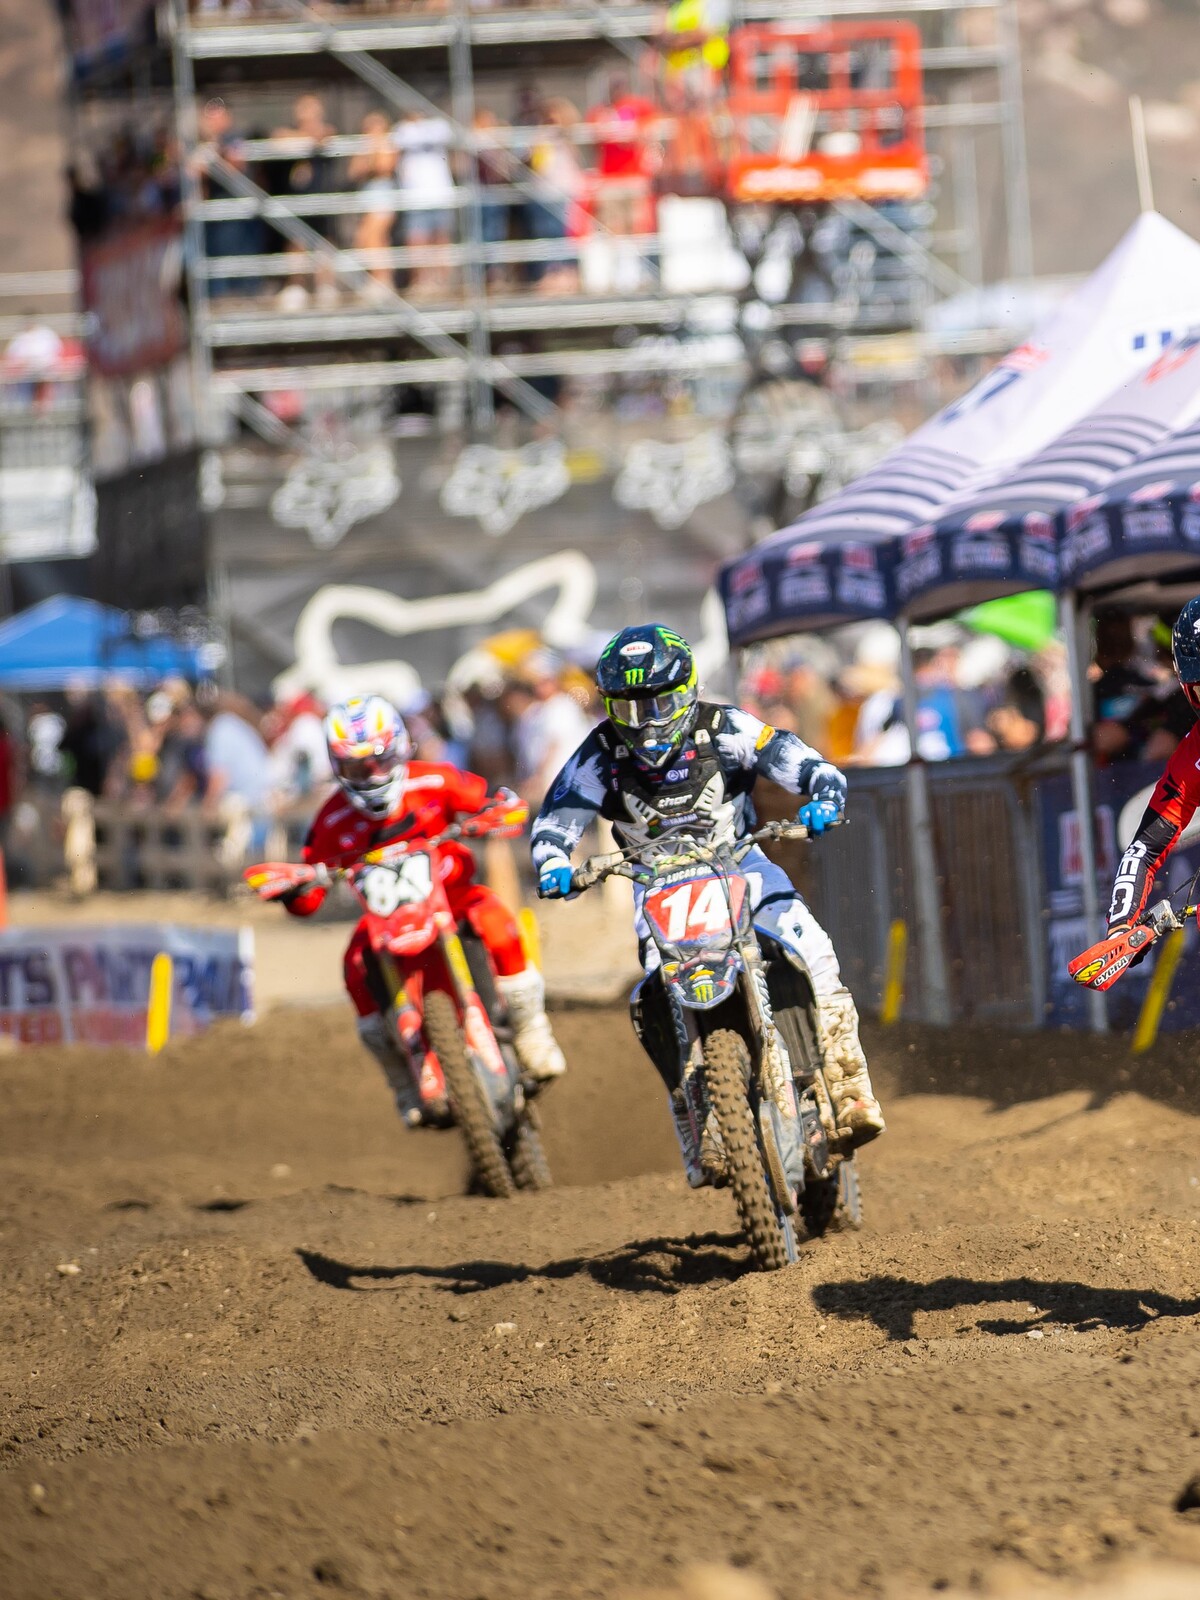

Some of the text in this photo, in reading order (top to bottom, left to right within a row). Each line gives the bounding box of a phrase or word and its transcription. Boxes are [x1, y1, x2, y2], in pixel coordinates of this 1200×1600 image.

[666, 868, 696, 884] LUCAS
[661, 877, 734, 942] 14
[1095, 957, 1129, 987] CYCRA
